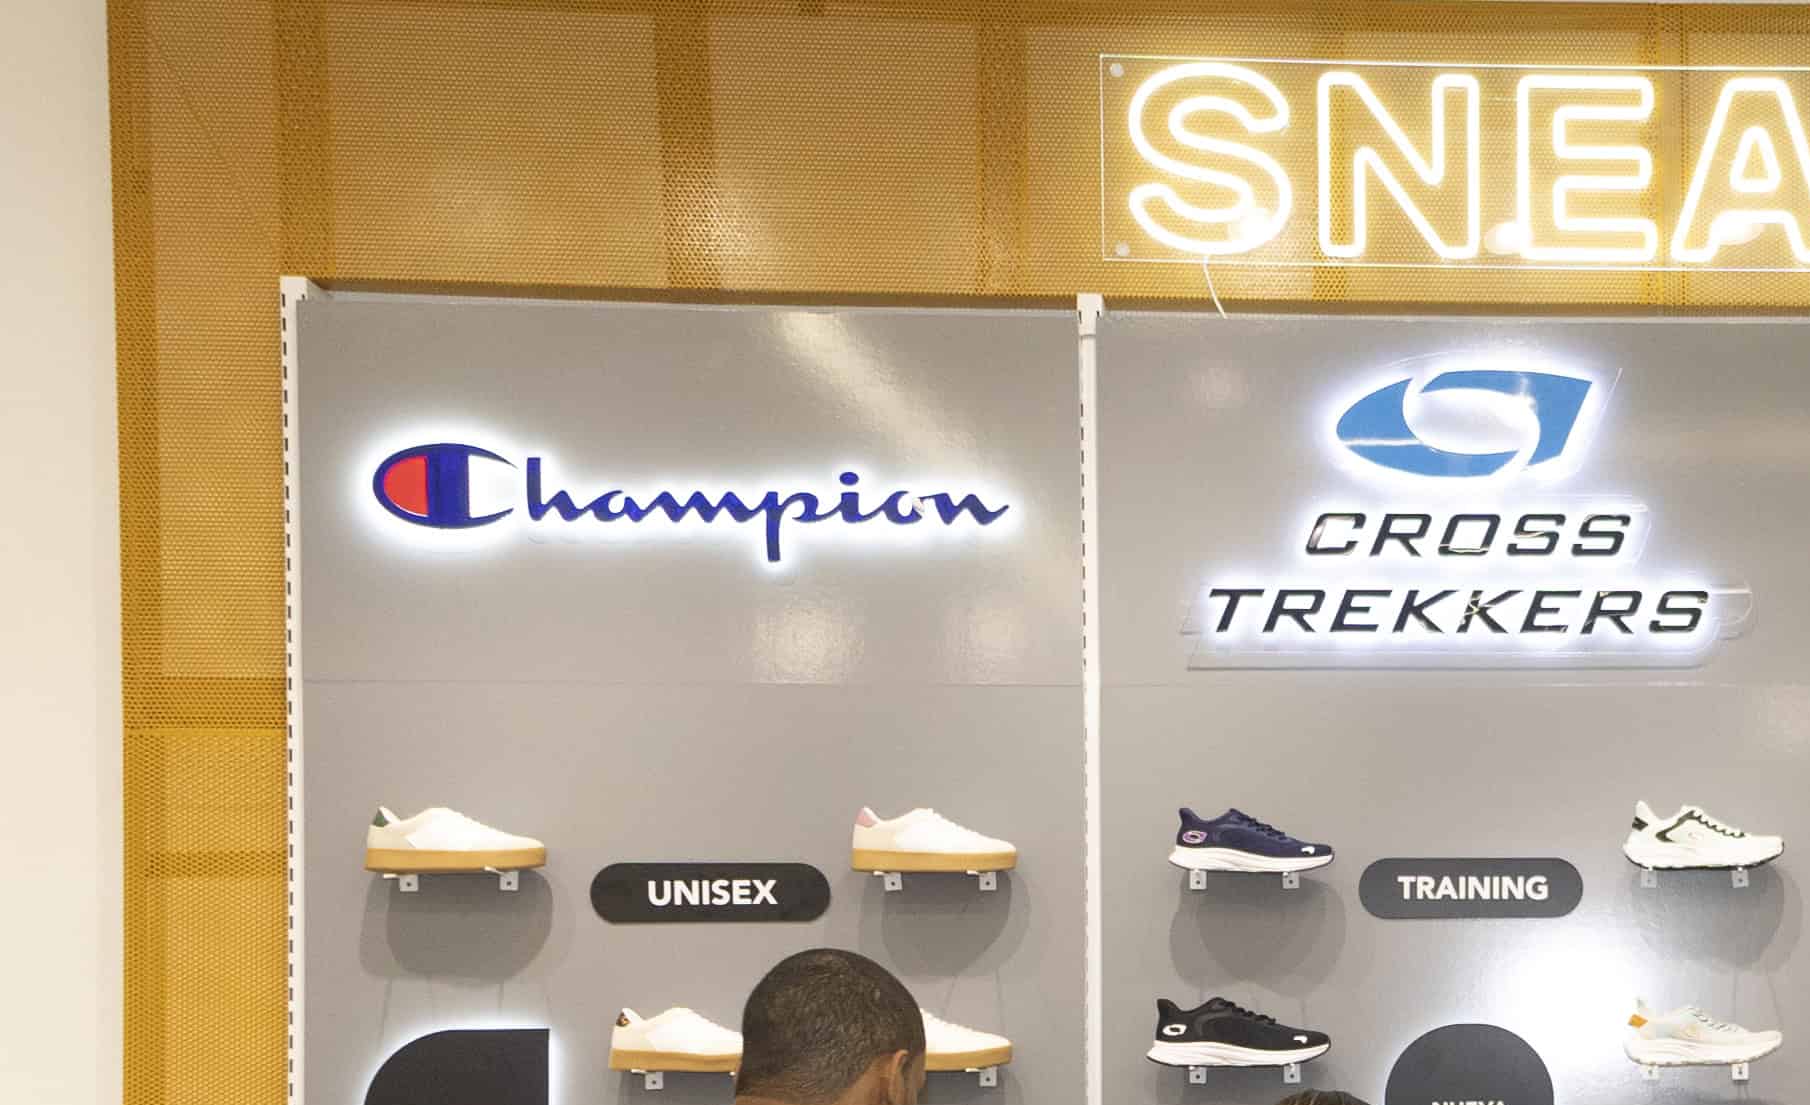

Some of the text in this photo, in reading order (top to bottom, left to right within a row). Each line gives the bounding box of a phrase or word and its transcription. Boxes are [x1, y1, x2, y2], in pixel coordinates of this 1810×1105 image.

[373, 443, 1009, 562] Champion
[1305, 512, 1631, 557] CROSS
[1209, 589, 1708, 635] TREKKERS
[648, 880, 777, 907] UNISEX
[1398, 876, 1549, 901] TRAINING
